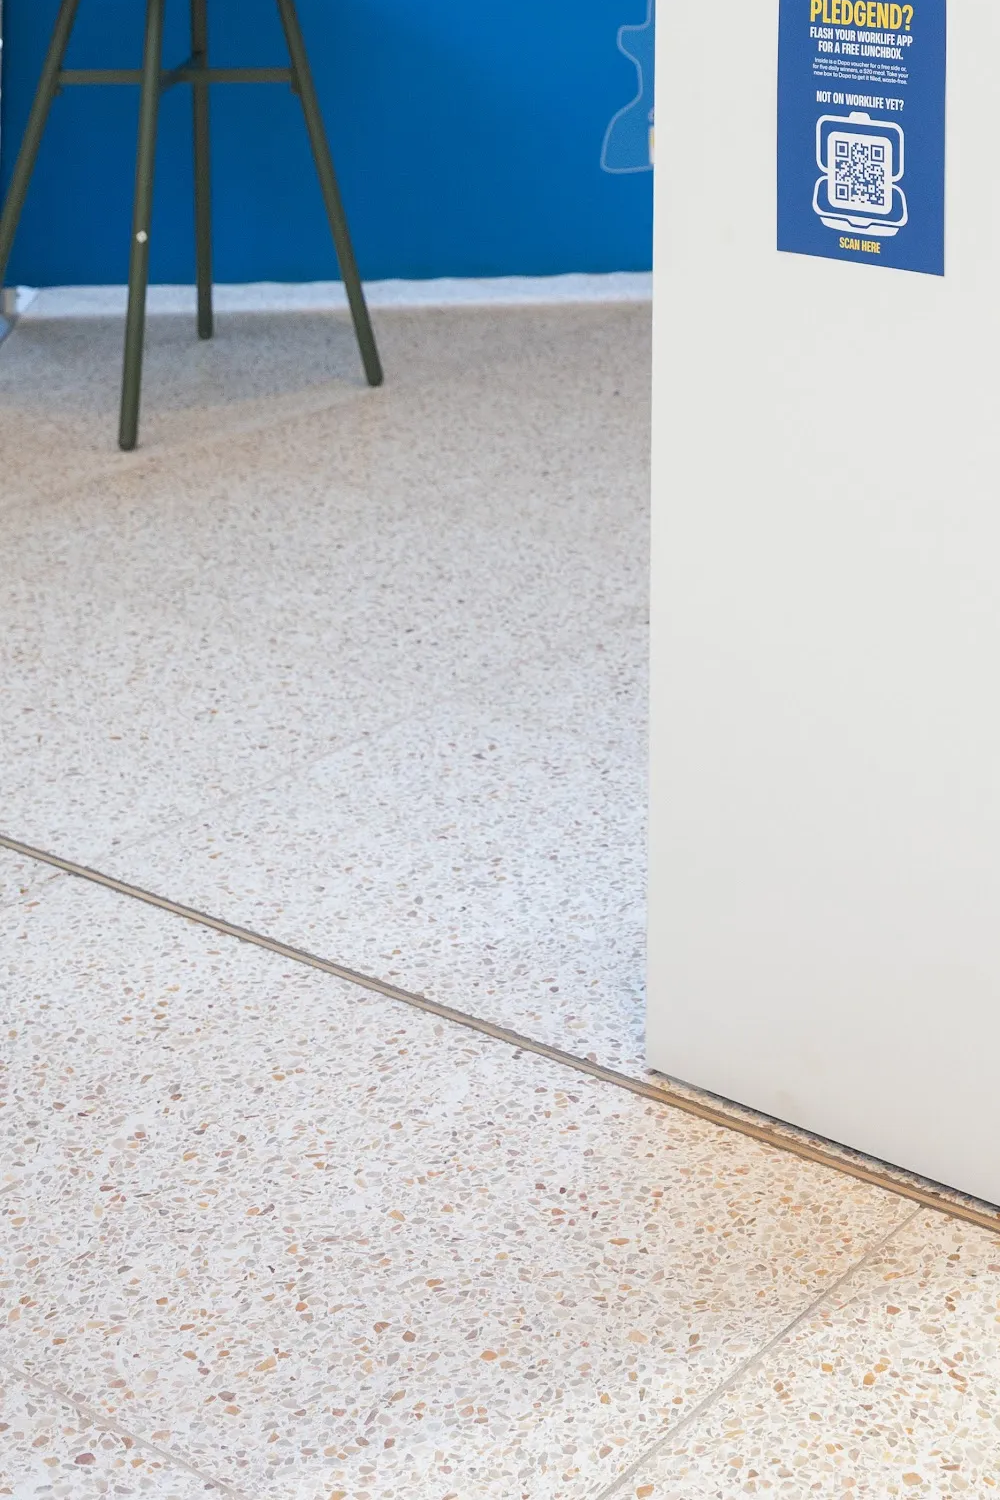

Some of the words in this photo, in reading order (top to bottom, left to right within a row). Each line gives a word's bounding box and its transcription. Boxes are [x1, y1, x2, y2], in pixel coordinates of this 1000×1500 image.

[810, 27, 833, 39] FLASH
[835, 28, 856, 42] YOUR
[857, 31, 895, 45] WORKLIFE
[897, 35, 913, 47] APP
[818, 40, 833, 53] FOR
[834, 42, 840, 54] A
[842, 43, 859, 56] FREE
[861, 44, 904, 60] LUNCHBOX.
[816, 90, 831, 103] NOT
[833, 92, 844, 104] ON
[845, 93, 884, 109] WORKLIFE
[885, 97, 904, 111] YET?
[839, 237, 860, 251] SCAN
[861, 240, 880, 254] HERE
